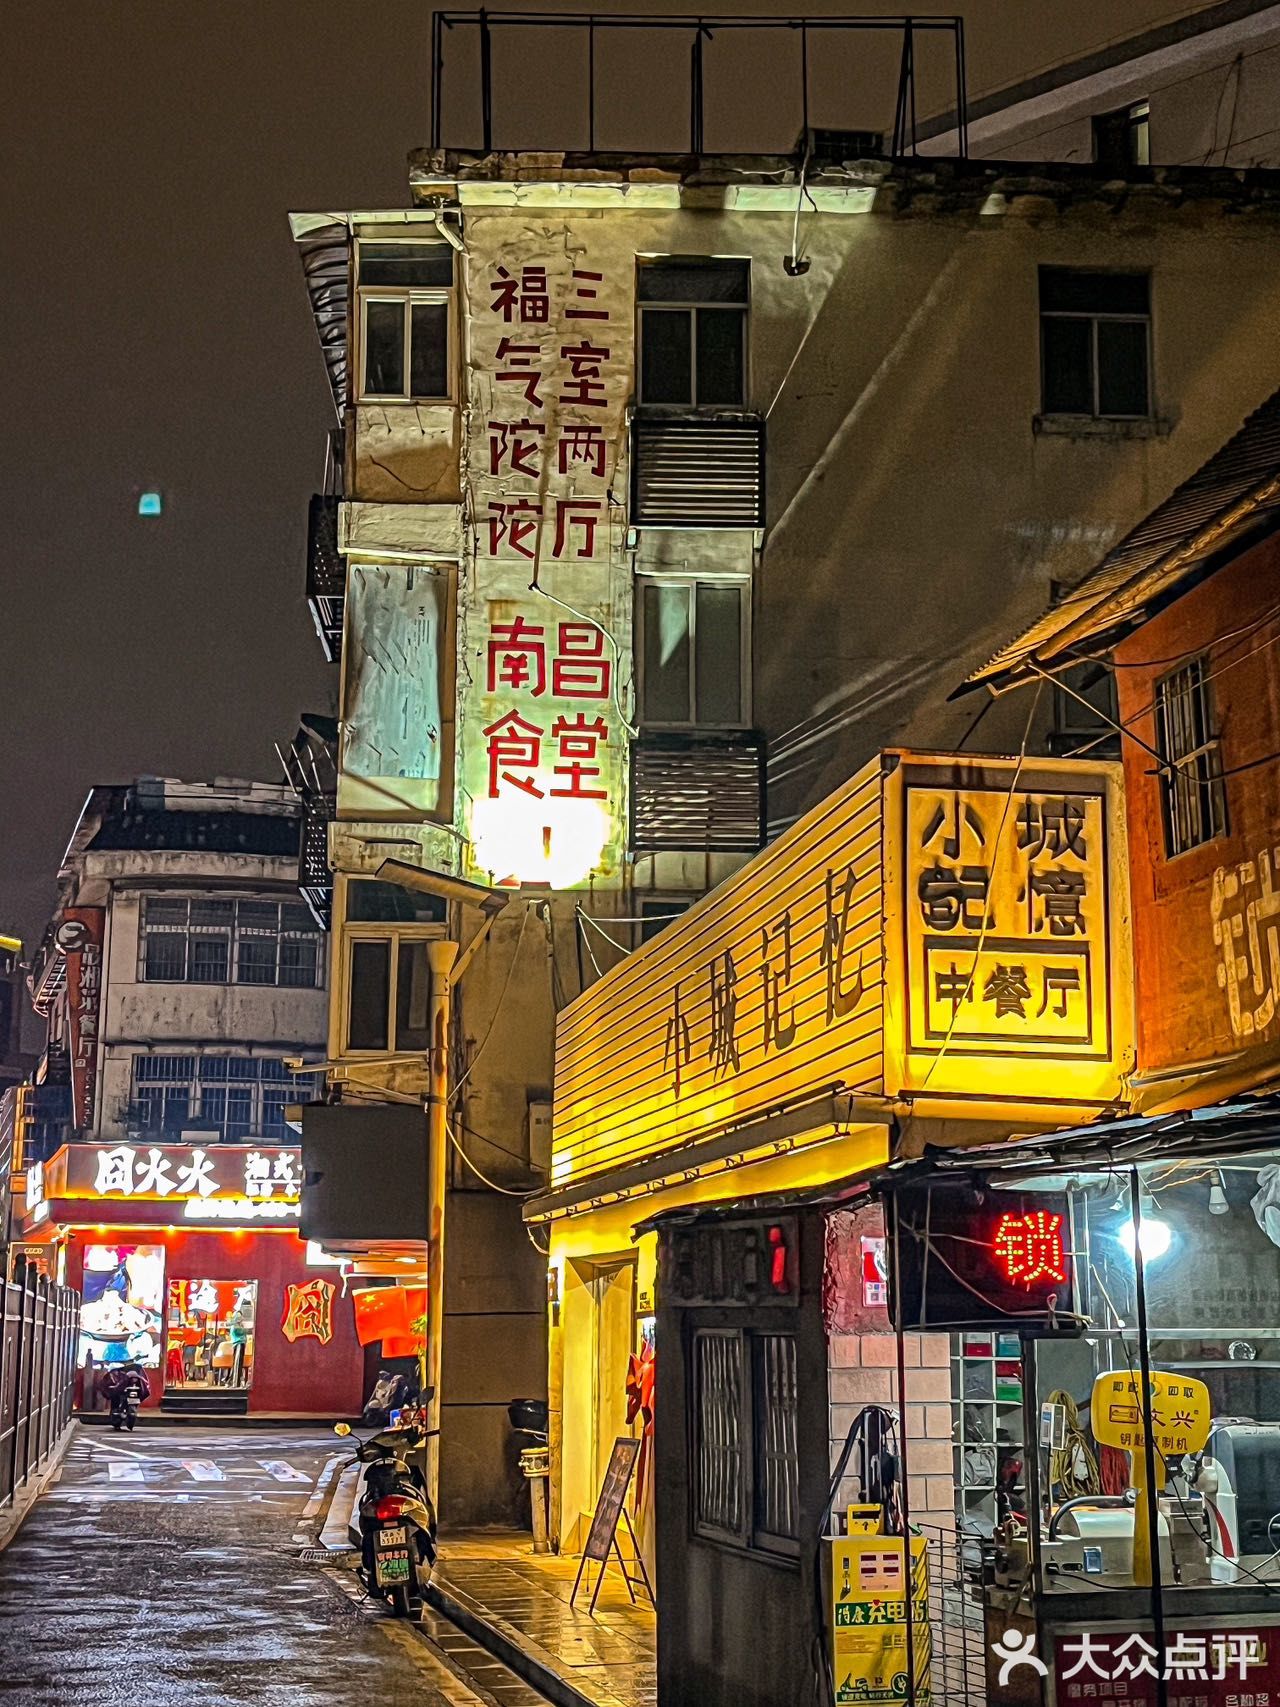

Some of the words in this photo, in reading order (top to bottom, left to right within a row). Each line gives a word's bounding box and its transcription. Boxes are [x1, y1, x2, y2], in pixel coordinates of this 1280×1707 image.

[551, 269, 610, 559] 三室两厅
[486, 616, 612, 700] 南昌
[482, 709, 609, 800] 食堂
[920, 790, 1087, 861] 小城
[934, 962, 1081, 1020] 中餐厅
[994, 1210, 1064, 1282] 锁
